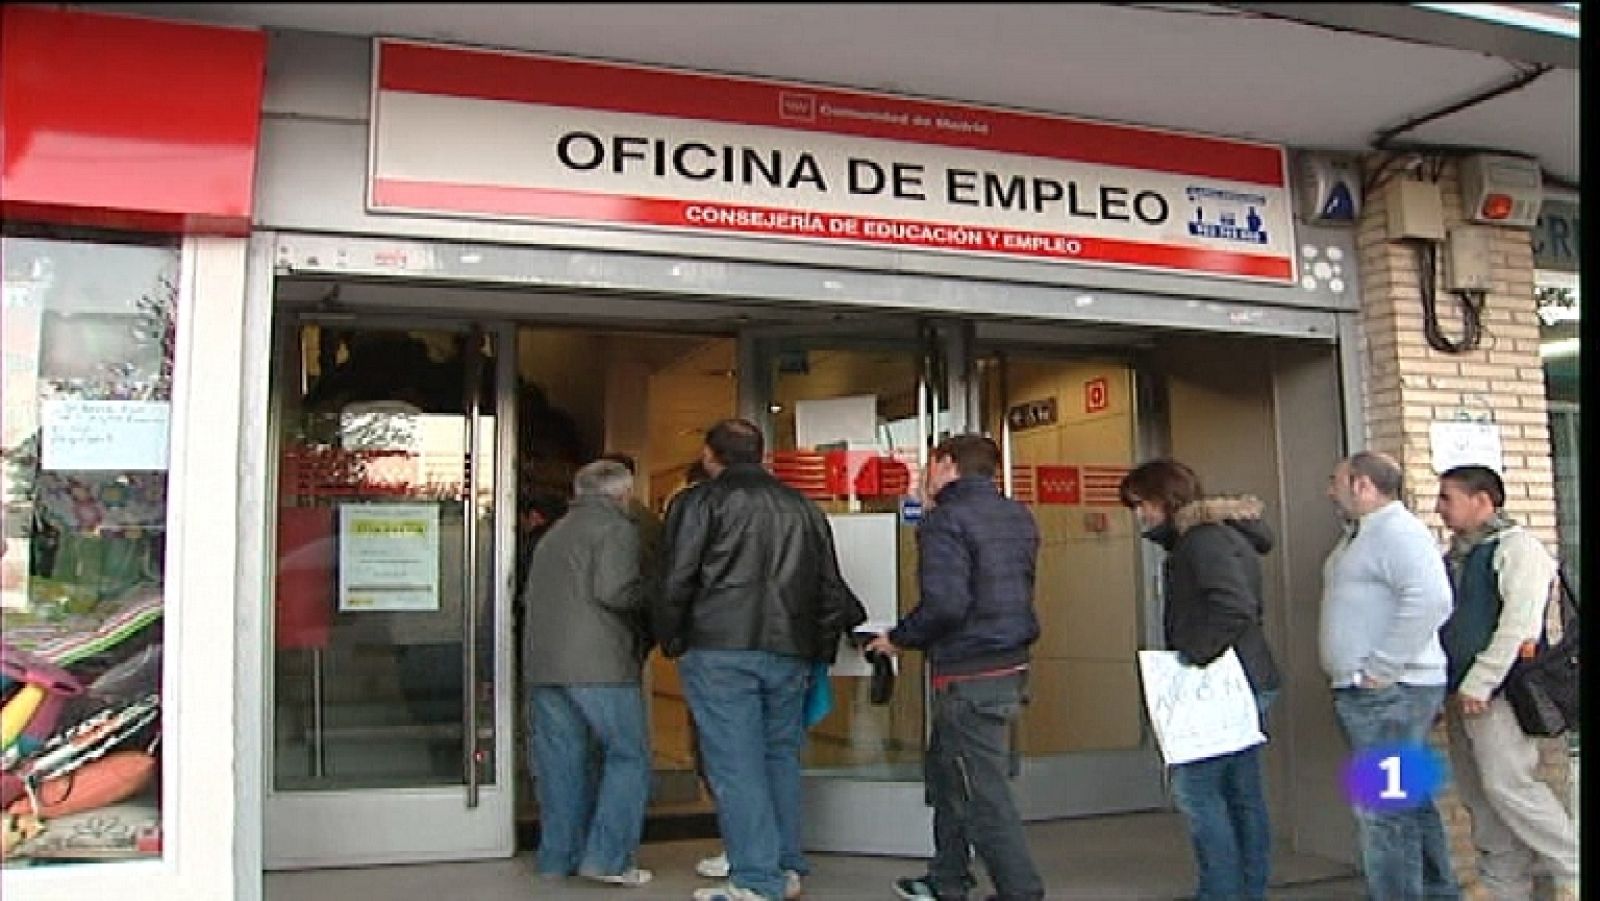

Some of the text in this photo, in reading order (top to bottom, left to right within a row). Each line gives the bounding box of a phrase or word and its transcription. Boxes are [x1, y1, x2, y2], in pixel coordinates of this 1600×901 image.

[556, 130, 1169, 226] OFICINA DE EMPLEO
[685, 204, 1082, 255] CONSEJERÍA DE EDUCACIÓN Y EMPLEO
